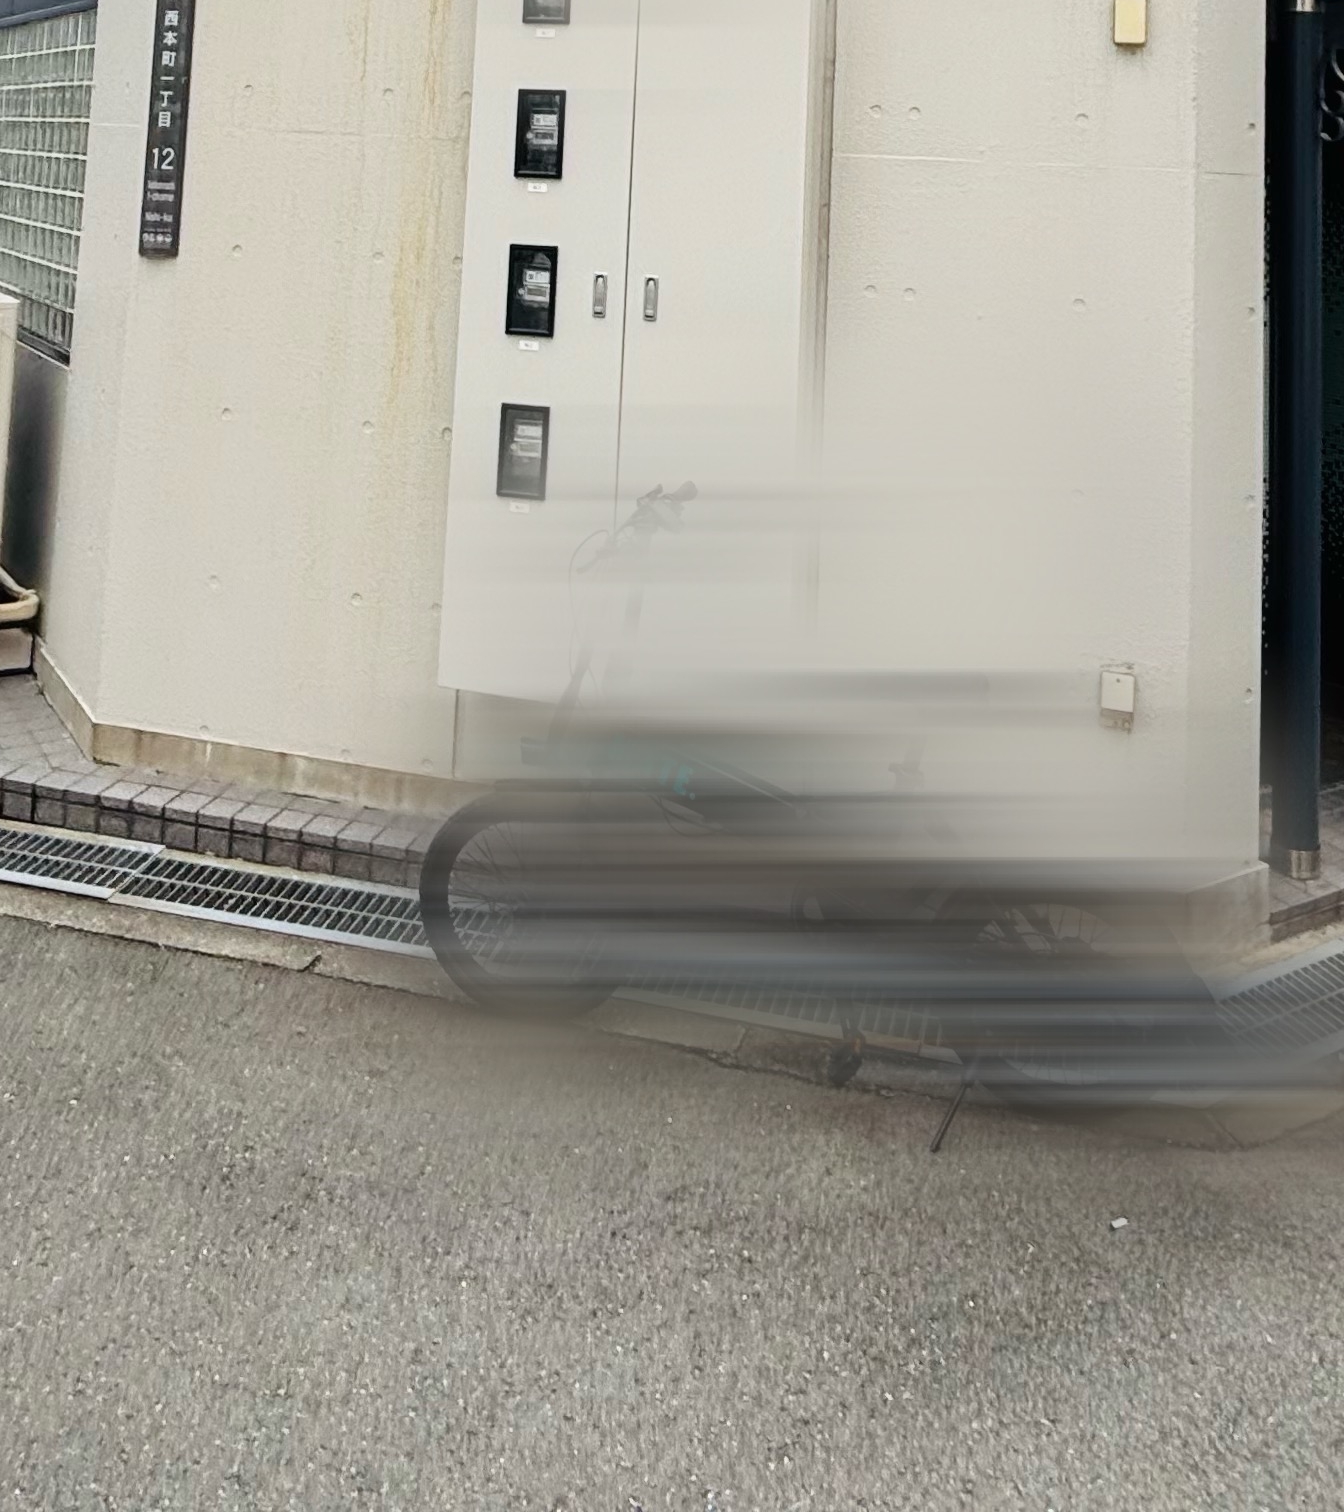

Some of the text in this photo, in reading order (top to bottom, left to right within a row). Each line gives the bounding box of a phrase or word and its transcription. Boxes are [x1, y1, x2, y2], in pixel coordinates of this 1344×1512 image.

[158, 10, 179, 128] 西本町一丁目
[152, 147, 175, 170] 12
